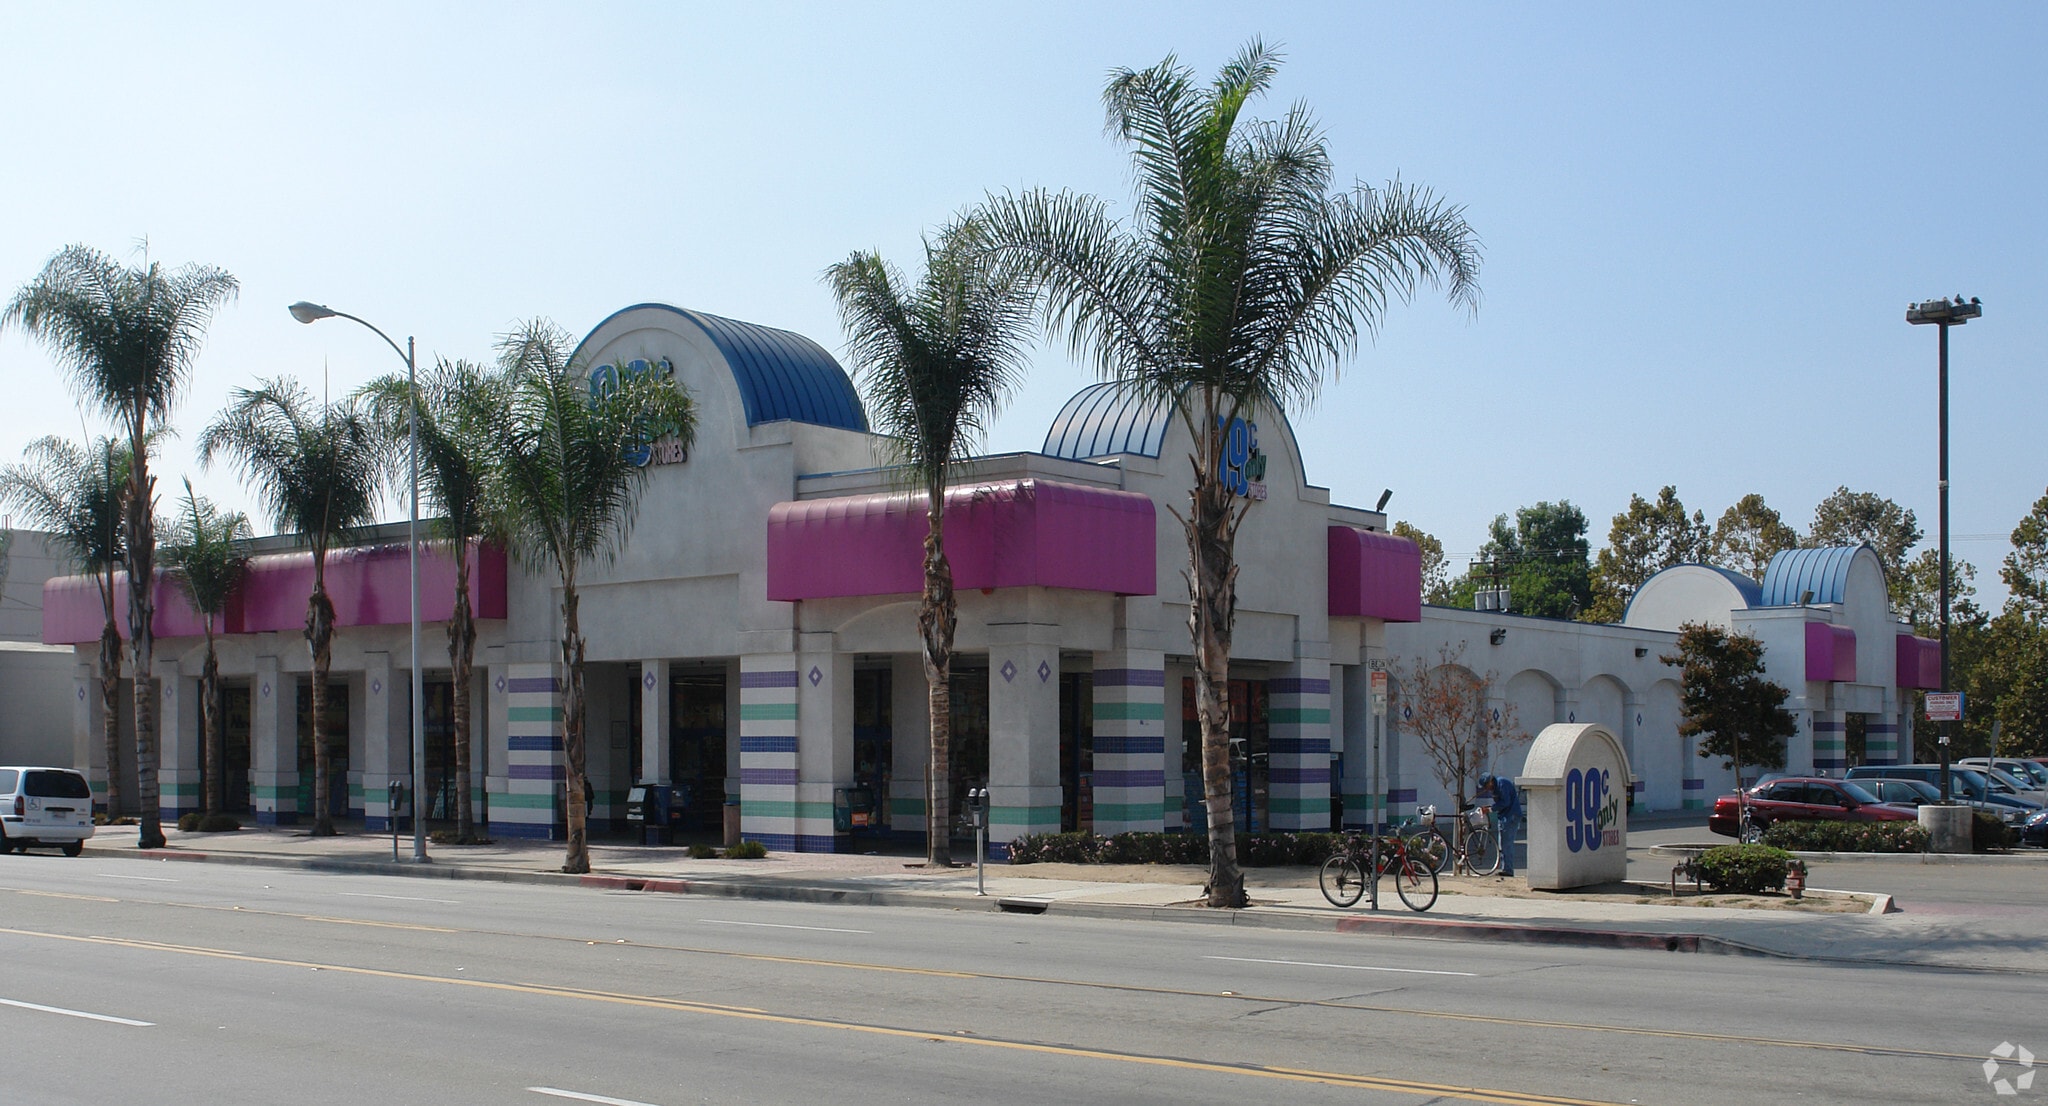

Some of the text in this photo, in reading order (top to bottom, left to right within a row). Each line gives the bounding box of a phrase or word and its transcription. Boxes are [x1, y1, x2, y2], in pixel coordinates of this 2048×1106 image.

[1245, 448, 1267, 481] only
[1596, 794, 1619, 830] only
[1602, 829, 1620, 847] STORES
